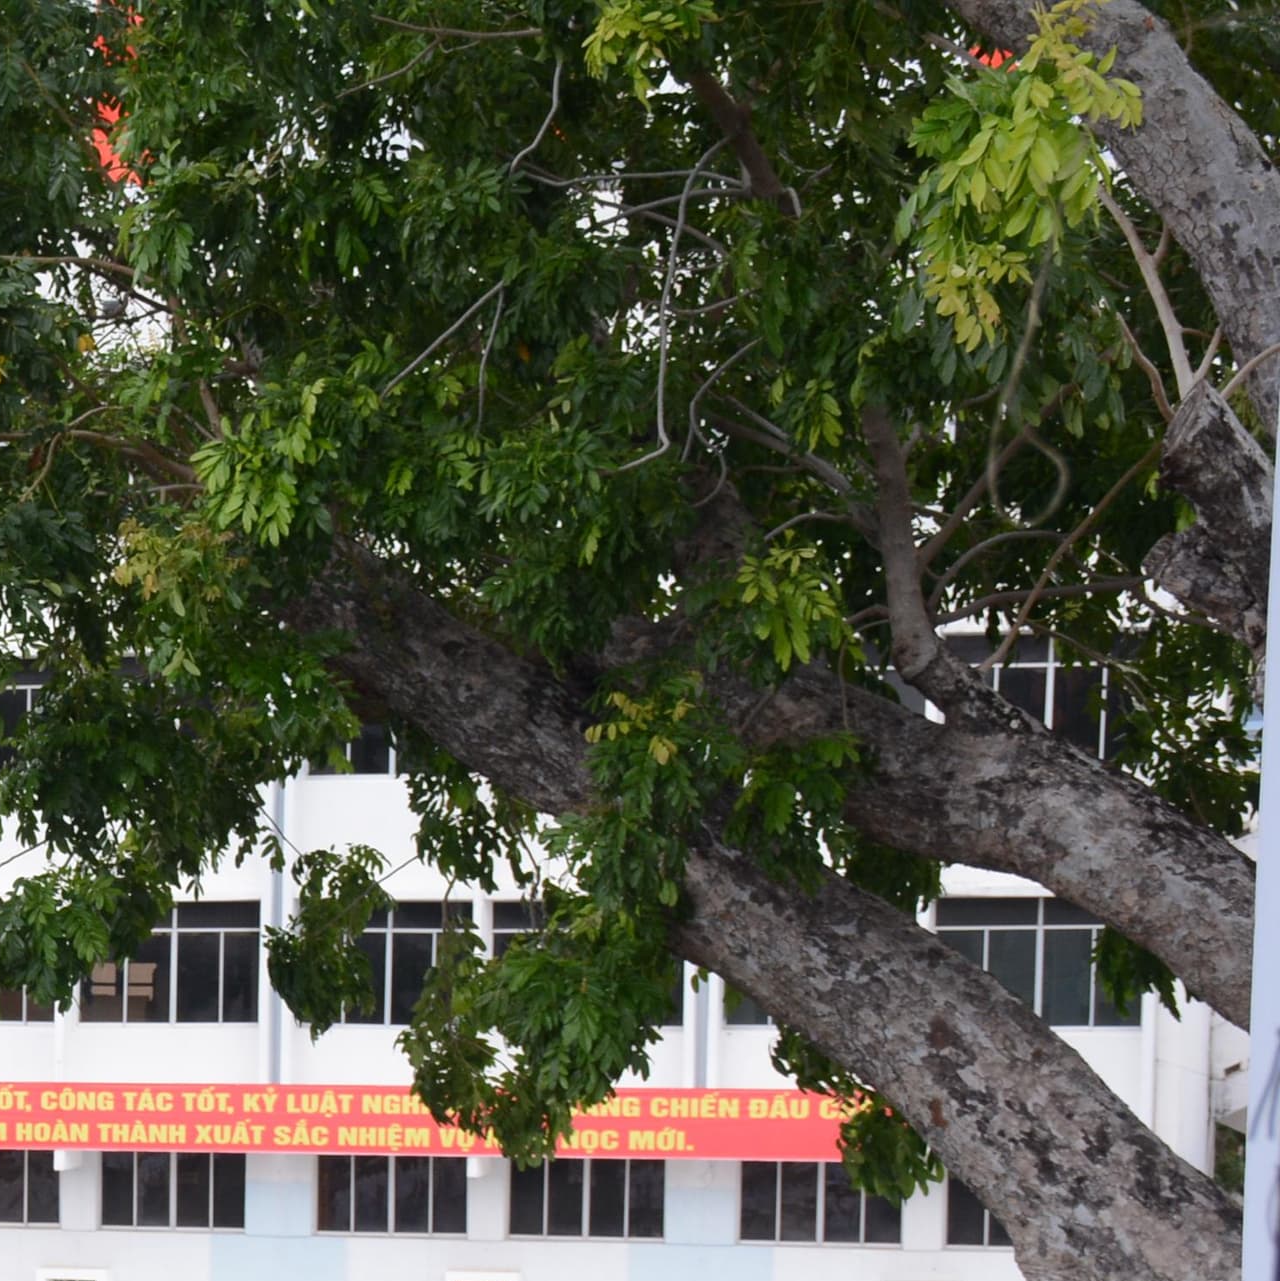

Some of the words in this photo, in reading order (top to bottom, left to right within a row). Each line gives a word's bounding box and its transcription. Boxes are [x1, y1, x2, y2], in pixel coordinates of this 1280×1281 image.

[41, 1087, 115, 1111] CÔNG
[123, 1088, 174, 1113] TÁC
[182, 1086, 235, 1115] TỐT,
[243, 1087, 278, 1114] KỶ
[287, 1090, 354, 1118] LUẬT
[362, 1094, 432, 1115] NGH
[649, 1092, 740, 1119] CHIẾN
[749, 1092, 810, 1119] ĐẤU
[15, 1119, 90, 1143] HOÀN
[97, 1120, 187, 1144] THÀNH
[194, 1118, 267, 1145] XUẤT
[273, 1118, 330, 1147] SẮC
[337, 1123, 431, 1152] NHIỆM
[440, 1127, 476, 1152] VỤ
[628, 1127, 695, 1152] MỚI.
